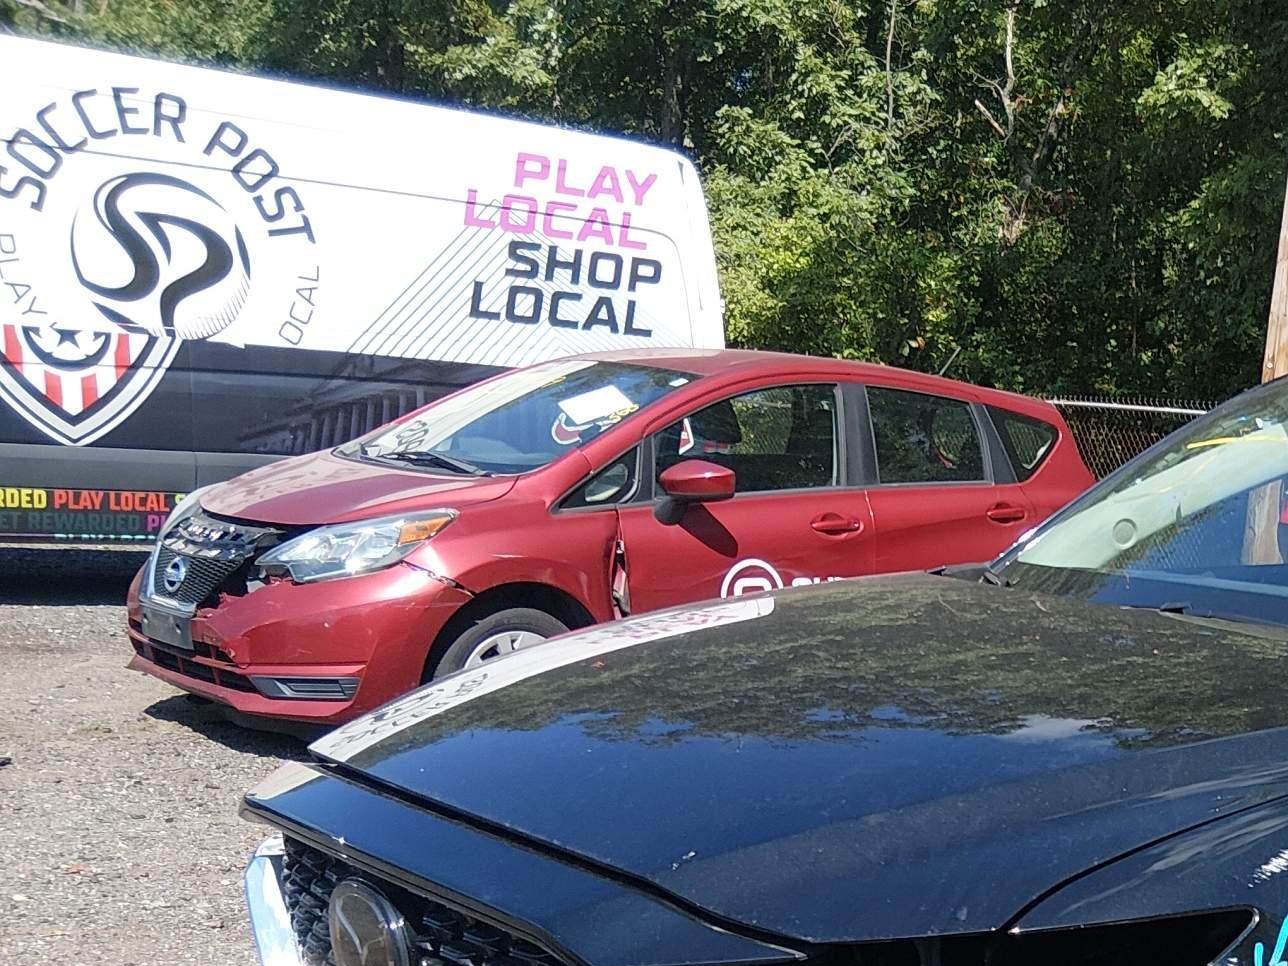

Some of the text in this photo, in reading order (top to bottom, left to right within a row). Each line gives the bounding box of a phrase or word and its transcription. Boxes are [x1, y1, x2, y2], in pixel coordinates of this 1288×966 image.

[0, 87, 316, 244] SOCCER POST
[514, 152, 658, 206] PLAY
[464, 189, 647, 250] LOCAL
[505, 240, 662, 292] SHOP
[469, 280, 653, 337] LOCAL
[27, 512, 141, 532] REWARDED
[54, 490, 104, 510] PLAY
[109, 491, 170, 512] LOCAL
